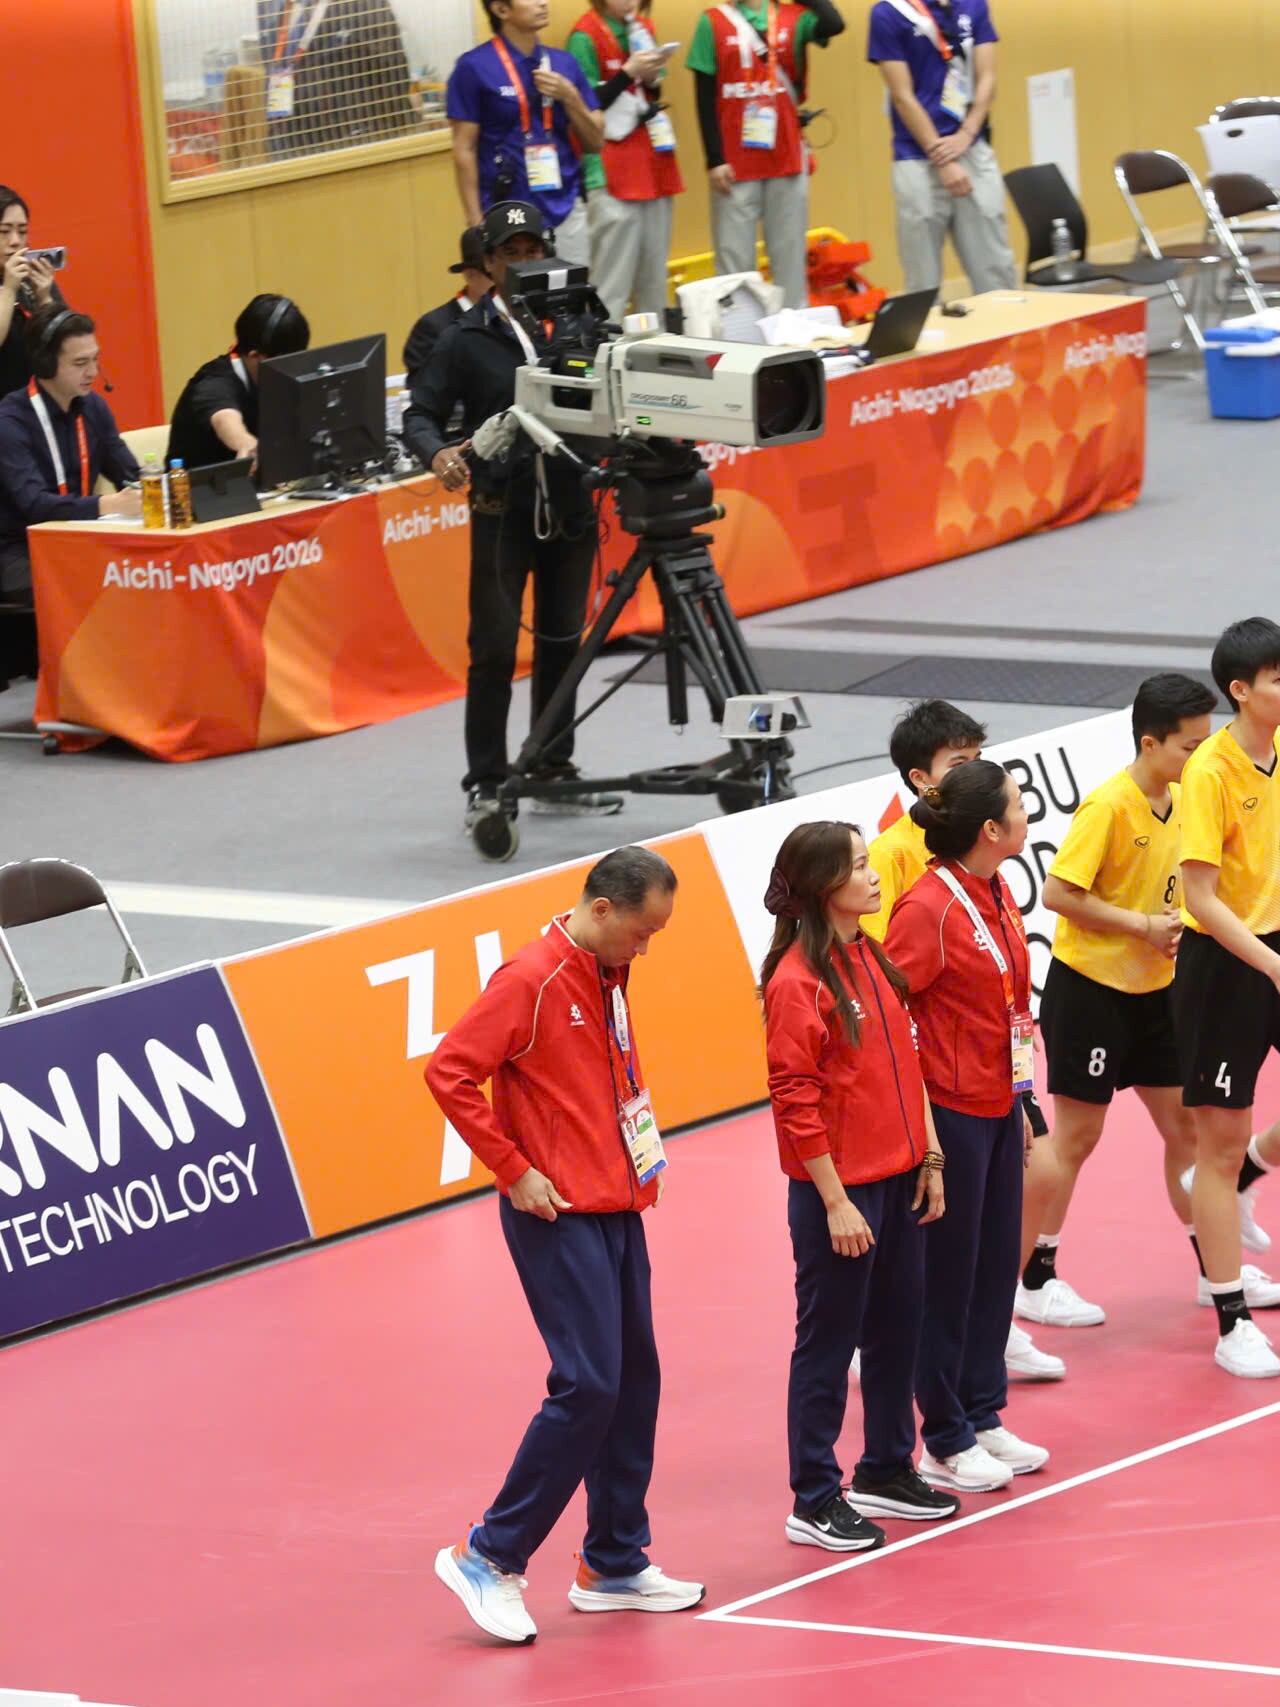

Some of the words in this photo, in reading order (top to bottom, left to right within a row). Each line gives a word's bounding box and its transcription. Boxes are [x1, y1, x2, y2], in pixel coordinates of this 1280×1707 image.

[850, 377, 969, 427] Aichi-Nagoya
[968, 362, 1016, 395] 2026
[103, 552, 271, 592] Aichi-Nagoya
[272, 537, 324, 573] 2026
[1164, 875, 1176, 905] 8
[1088, 1047, 1106, 1078] 8
[1214, 1062, 1232, 1097] 4
[0, 1143, 258, 1273] TECHNOLOGY
